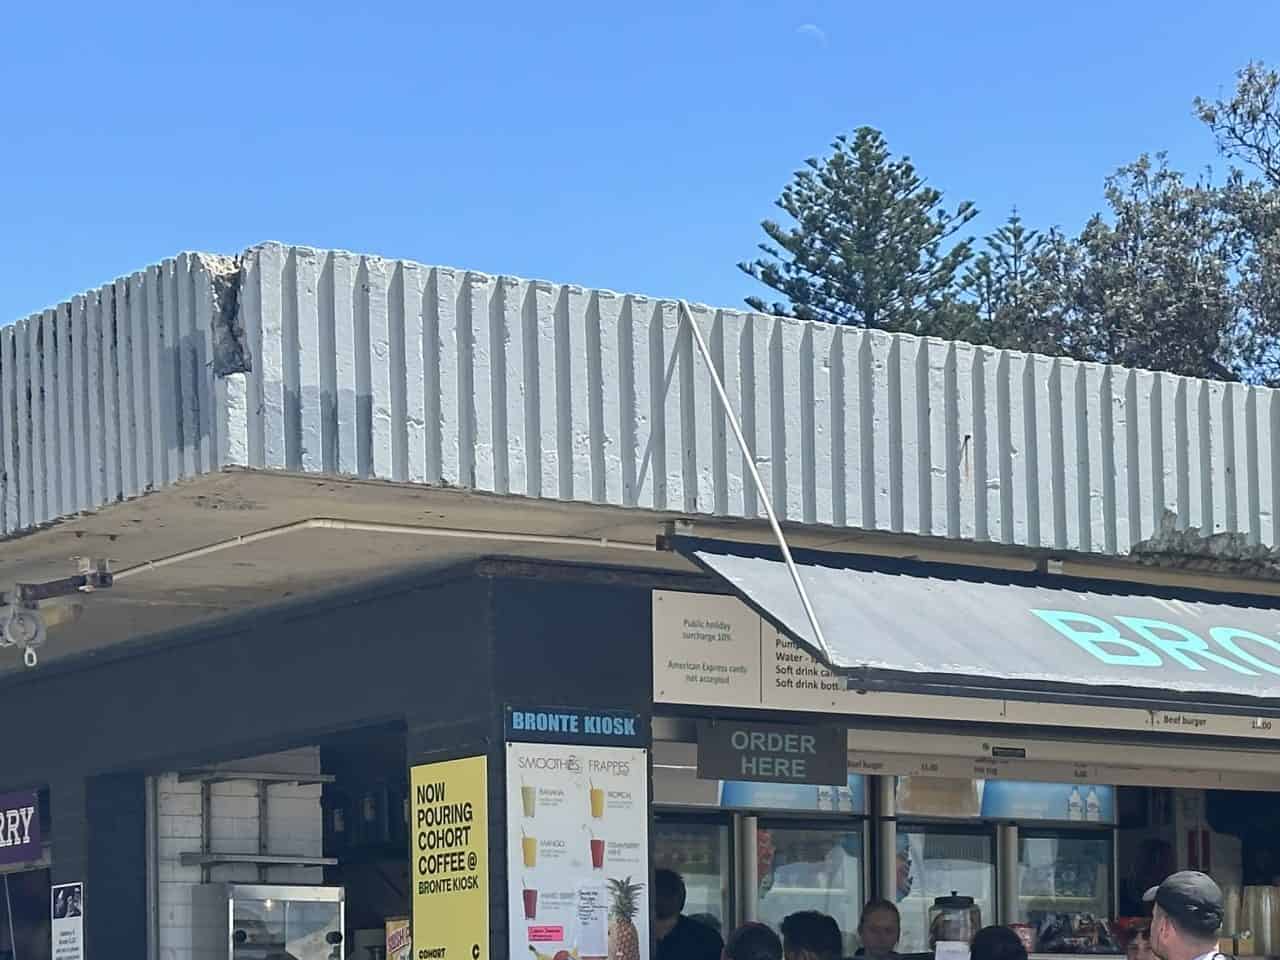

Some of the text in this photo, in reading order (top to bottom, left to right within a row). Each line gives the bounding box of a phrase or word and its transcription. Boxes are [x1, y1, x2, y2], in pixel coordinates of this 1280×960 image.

[682, 619, 731, 631] Public holiday
[682, 631, 715, 642] surcharge
[775, 651, 802, 662] Water
[668, 660, 700, 671] American
[702, 662, 727, 674] Express
[775, 664, 793, 674] Soft
[795, 667, 818, 676] drink
[775, 678, 793, 688] Soft
[795, 680, 818, 689] drink
[512, 711, 636, 736] BRONTE KIOSK
[1163, 715, 1181, 725] Beef
[1182, 716, 1207, 728] burger
[731, 730, 817, 754] ORDER
[741, 755, 807, 778] HERE
[416, 782, 446, 805] NOW
[417, 802, 473, 829] POURING
[418, 826, 472, 851] COHORT
[418, 851, 478, 875] COFFEE @
[418, 875, 479, 895] BRONTE KIOSK
[419, 947, 446, 960] COHORT
